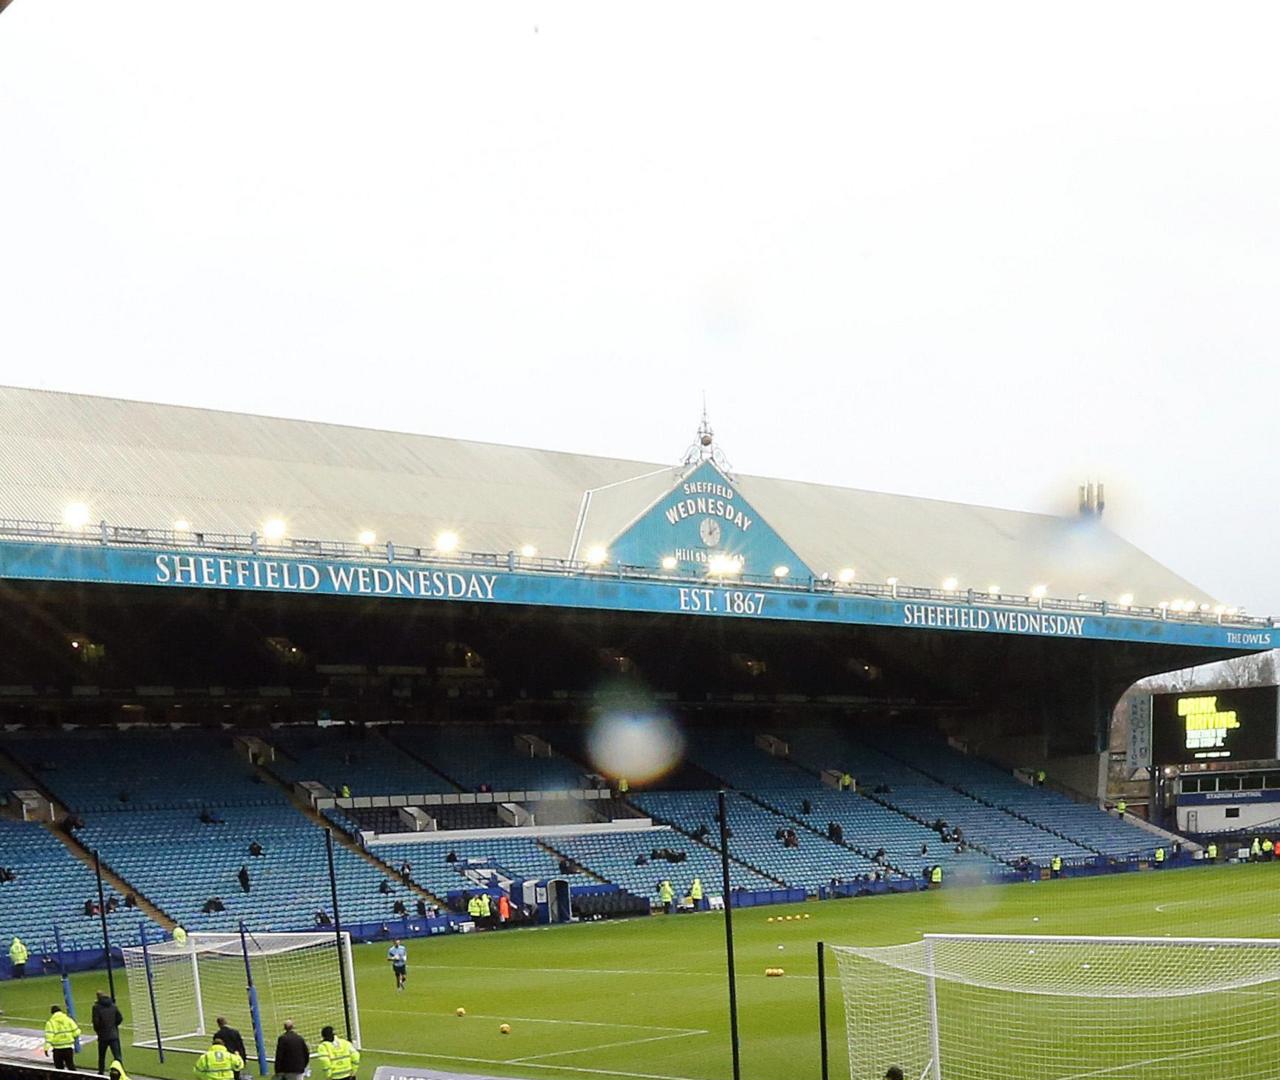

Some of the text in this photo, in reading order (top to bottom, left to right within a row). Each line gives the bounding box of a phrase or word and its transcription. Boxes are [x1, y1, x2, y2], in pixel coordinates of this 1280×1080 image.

[683, 481, 734, 500] SHEFFIELD
[665, 497, 753, 532] WEDNESDAY
[155, 554, 498, 600] SHEFFIELD WEDNESDAY
[678, 587, 766, 615] EST. 1867
[904, 603, 1086, 636] SHEFFIELD WEDNESDAY
[1226, 632, 1272, 645] THE OWLS
